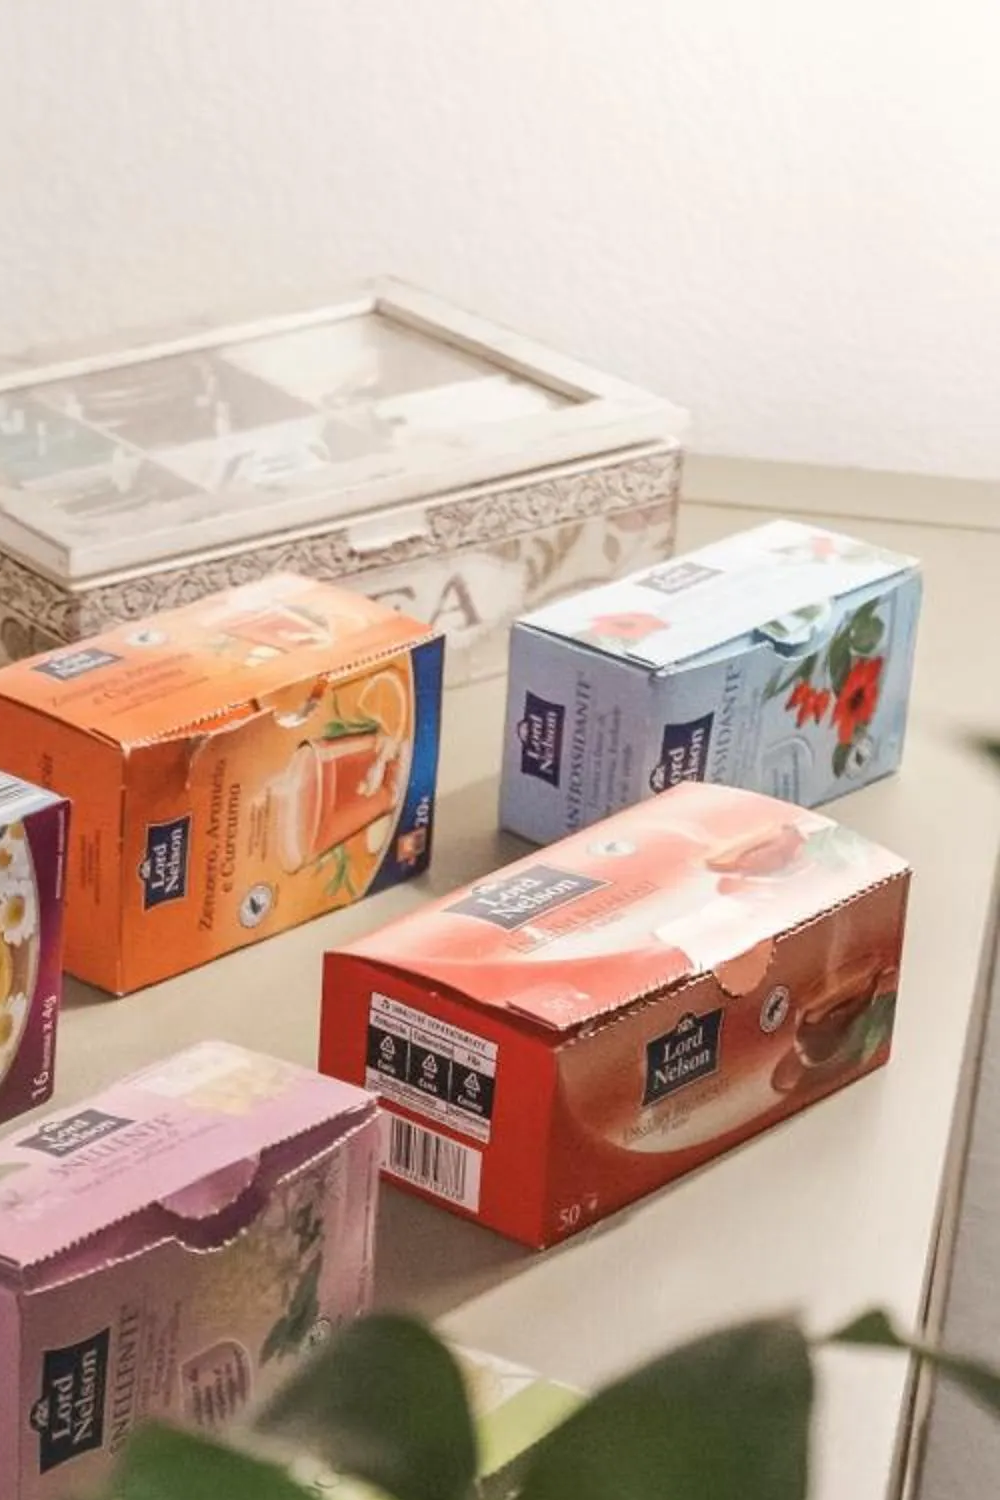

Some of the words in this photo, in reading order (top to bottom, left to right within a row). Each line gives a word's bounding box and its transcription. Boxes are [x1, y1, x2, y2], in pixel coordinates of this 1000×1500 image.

[528, 713, 544, 760] Lord
[540, 711, 557, 776] Nelson
[681, 727, 705, 782] lson
[668, 746, 685, 785] ord
[221, 783, 242, 878] Curcuma
[151, 843, 167, 889] Lord
[165, 828, 184, 893] Nelson
[477, 876, 544, 908] Lord
[489, 878, 581, 920] Nelson
[662, 1025, 704, 1064] Lord
[31, 1071, 49, 1100] 16
[653, 1049, 710, 1091] Nelson
[558, 1203, 581, 1231] 50
[52, 1374, 74, 1441] Lord
[72, 1350, 98, 1445] Nelson
